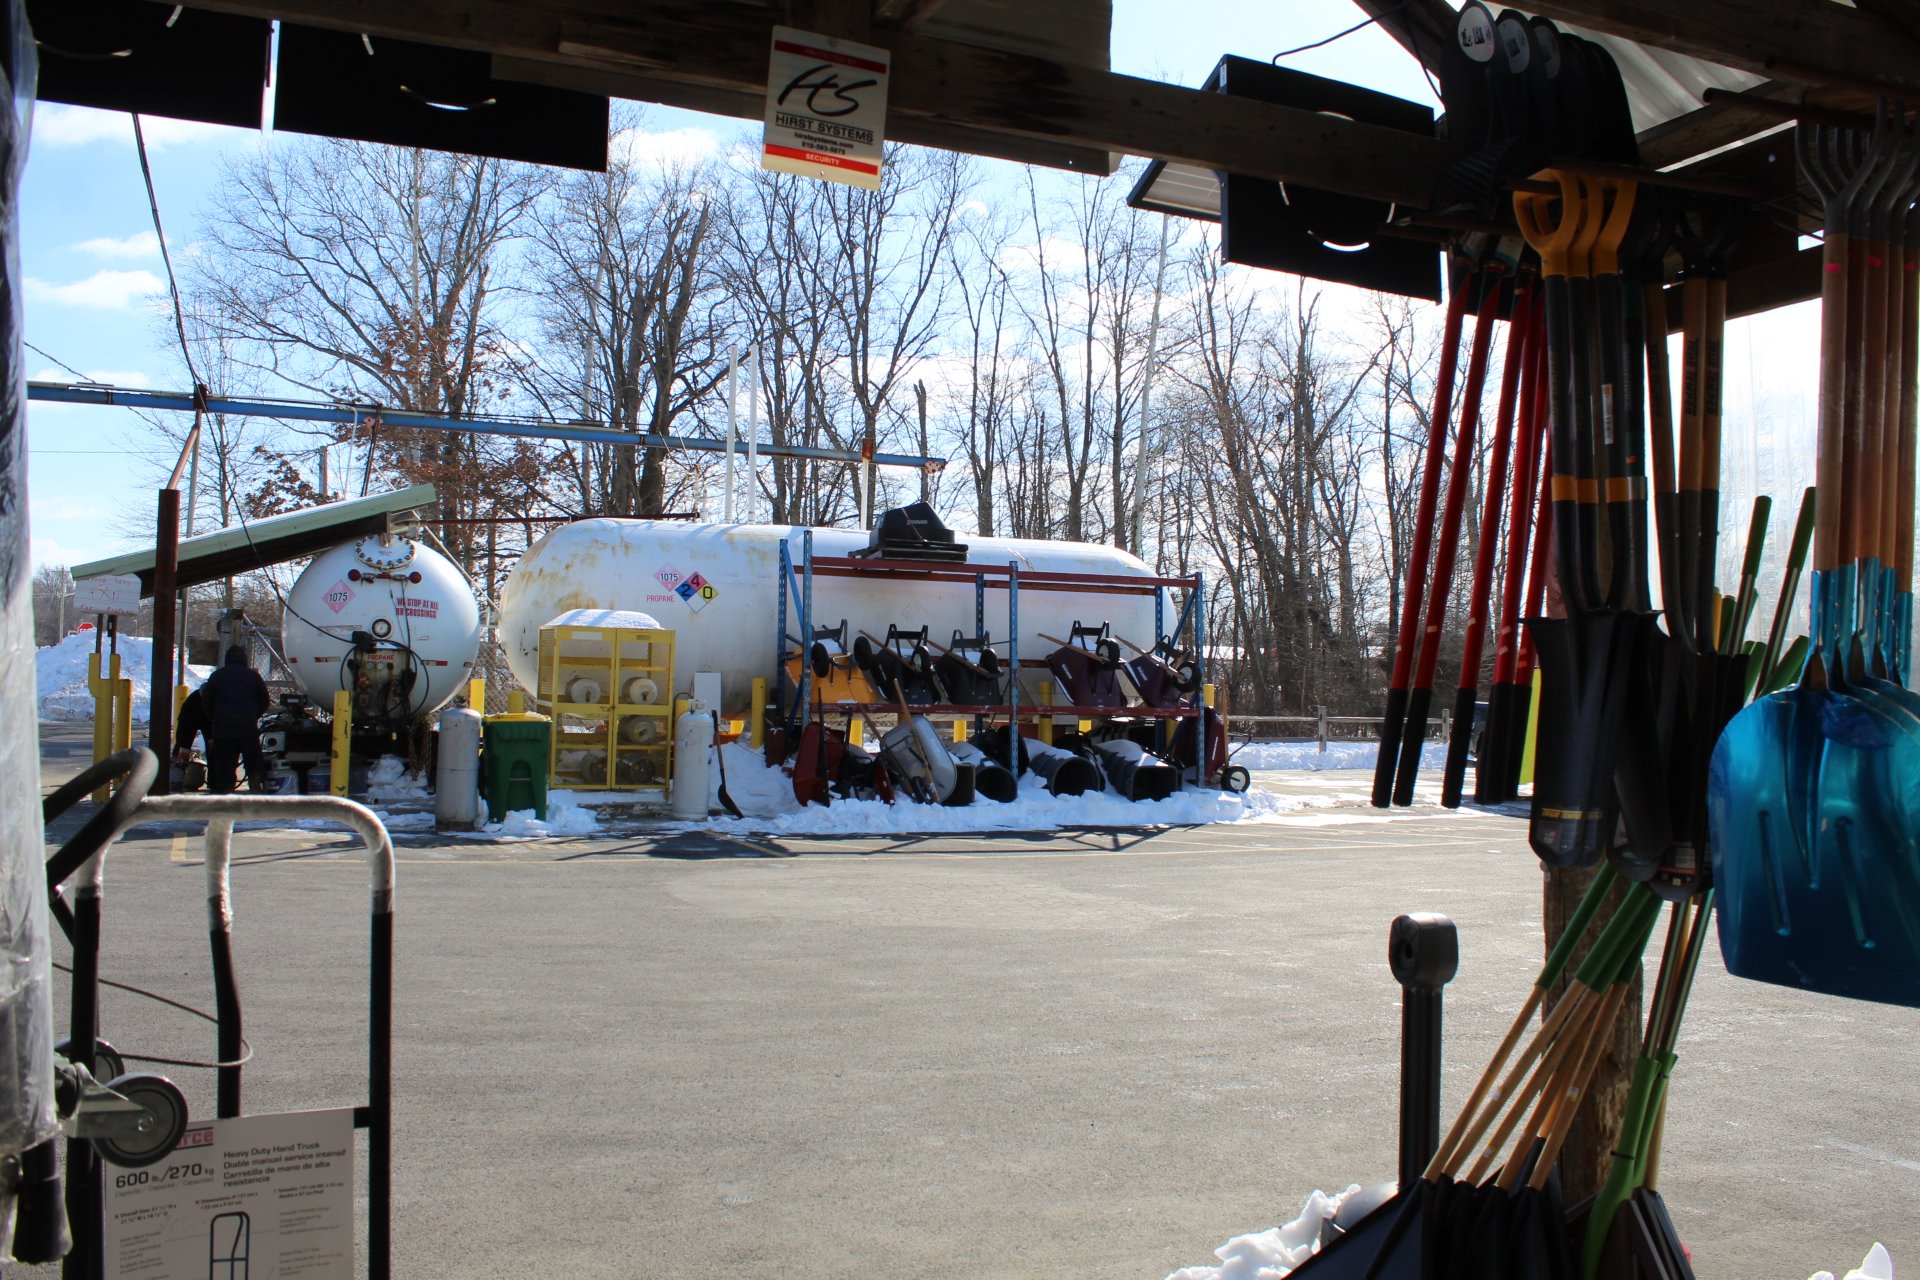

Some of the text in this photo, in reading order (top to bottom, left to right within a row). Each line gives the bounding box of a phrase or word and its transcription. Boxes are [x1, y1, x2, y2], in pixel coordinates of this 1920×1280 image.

[776, 114, 874, 143] HIRST SYSTEMS
[806, 153, 840, 166] SECURITY
[660, 574, 678, 582] 1075
[691, 575, 700, 587] 4
[329, 592, 348, 602] 1075
[681, 584, 712, 600] 2 0
[407, 598, 421, 607] STOP
[405, 608, 436, 618] CROSSINGS
[224, 1142, 320, 1159] Heavy Duty Hand Truck
[224, 1149, 346, 1169] Diable manuel service intensif
[116, 1171, 149, 1188] 600
[224, 1169, 263, 1180] Carretilla
[224, 1175, 270, 1187] resistencia
